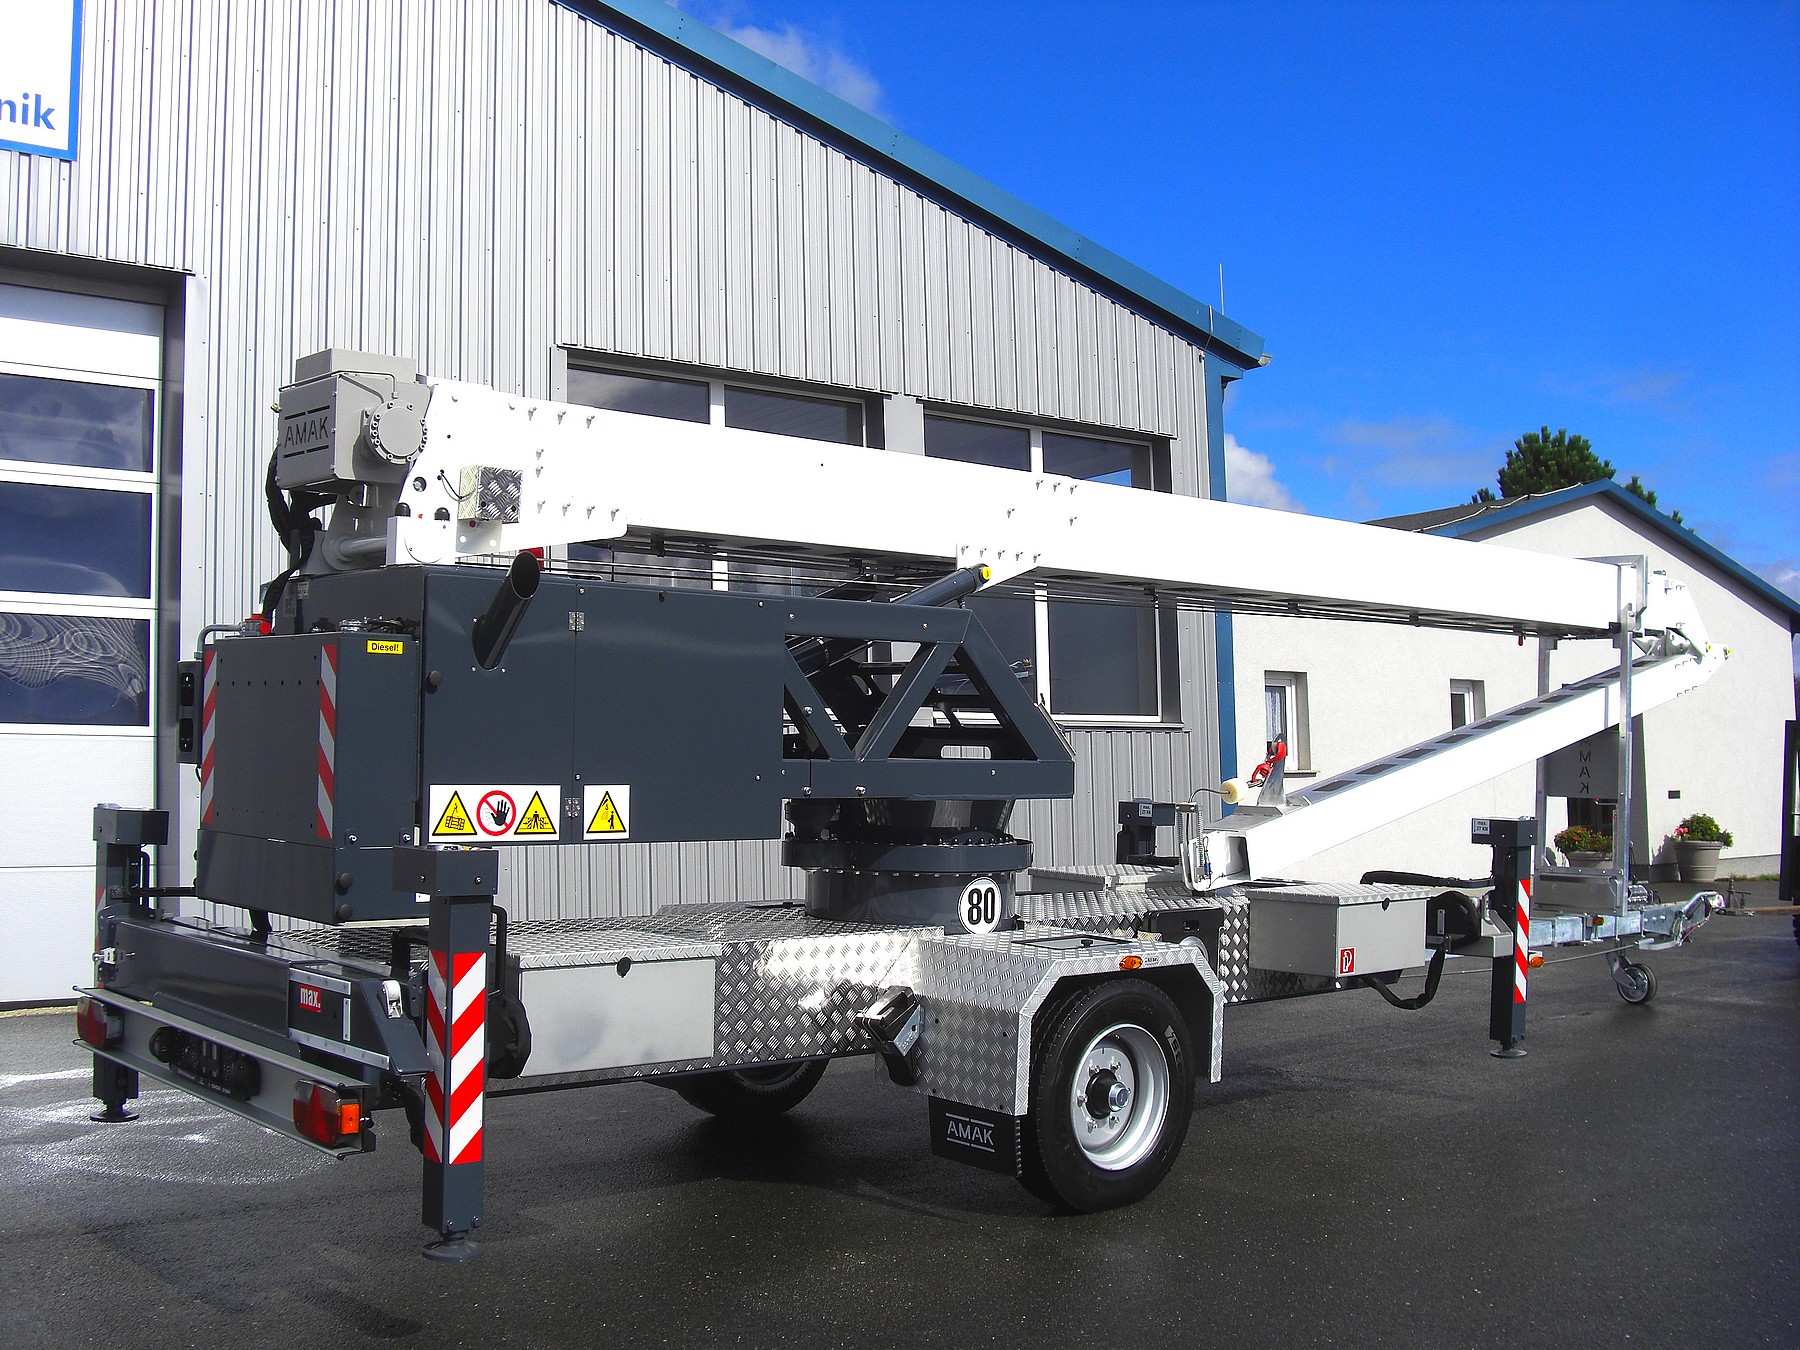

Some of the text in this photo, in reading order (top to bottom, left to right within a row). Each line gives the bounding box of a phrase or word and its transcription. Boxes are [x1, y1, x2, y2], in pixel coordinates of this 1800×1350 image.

[284, 416, 329, 448] AMAK
[371, 642, 399, 652] Diesel!
[968, 887, 995, 925] 80
[947, 1120, 994, 1146] AMAK
